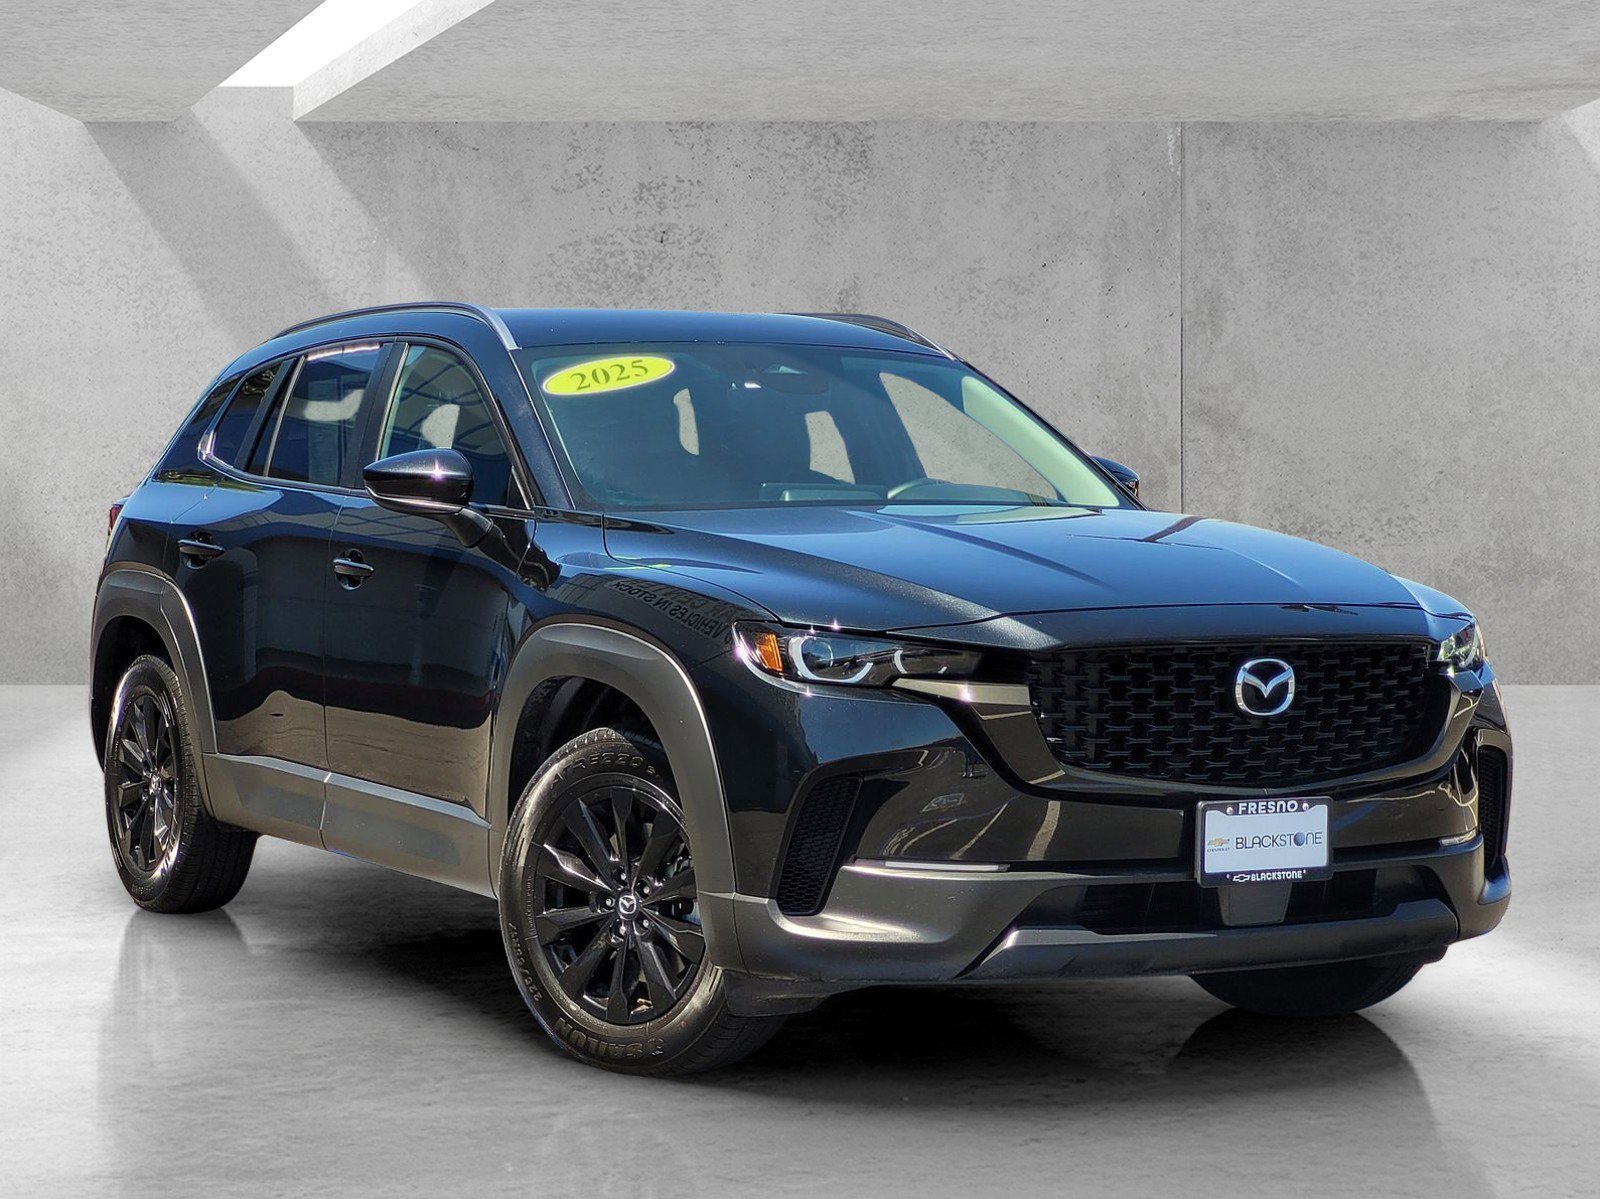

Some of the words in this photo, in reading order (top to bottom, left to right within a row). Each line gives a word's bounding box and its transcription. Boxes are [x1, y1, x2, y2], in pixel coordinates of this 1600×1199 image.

[569, 359, 649, 391] 2025
[1238, 800, 1299, 815] FRESNO
[1235, 832, 1323, 850] BLACKSTONE
[1250, 870, 1303, 882] BLACKSTONE
